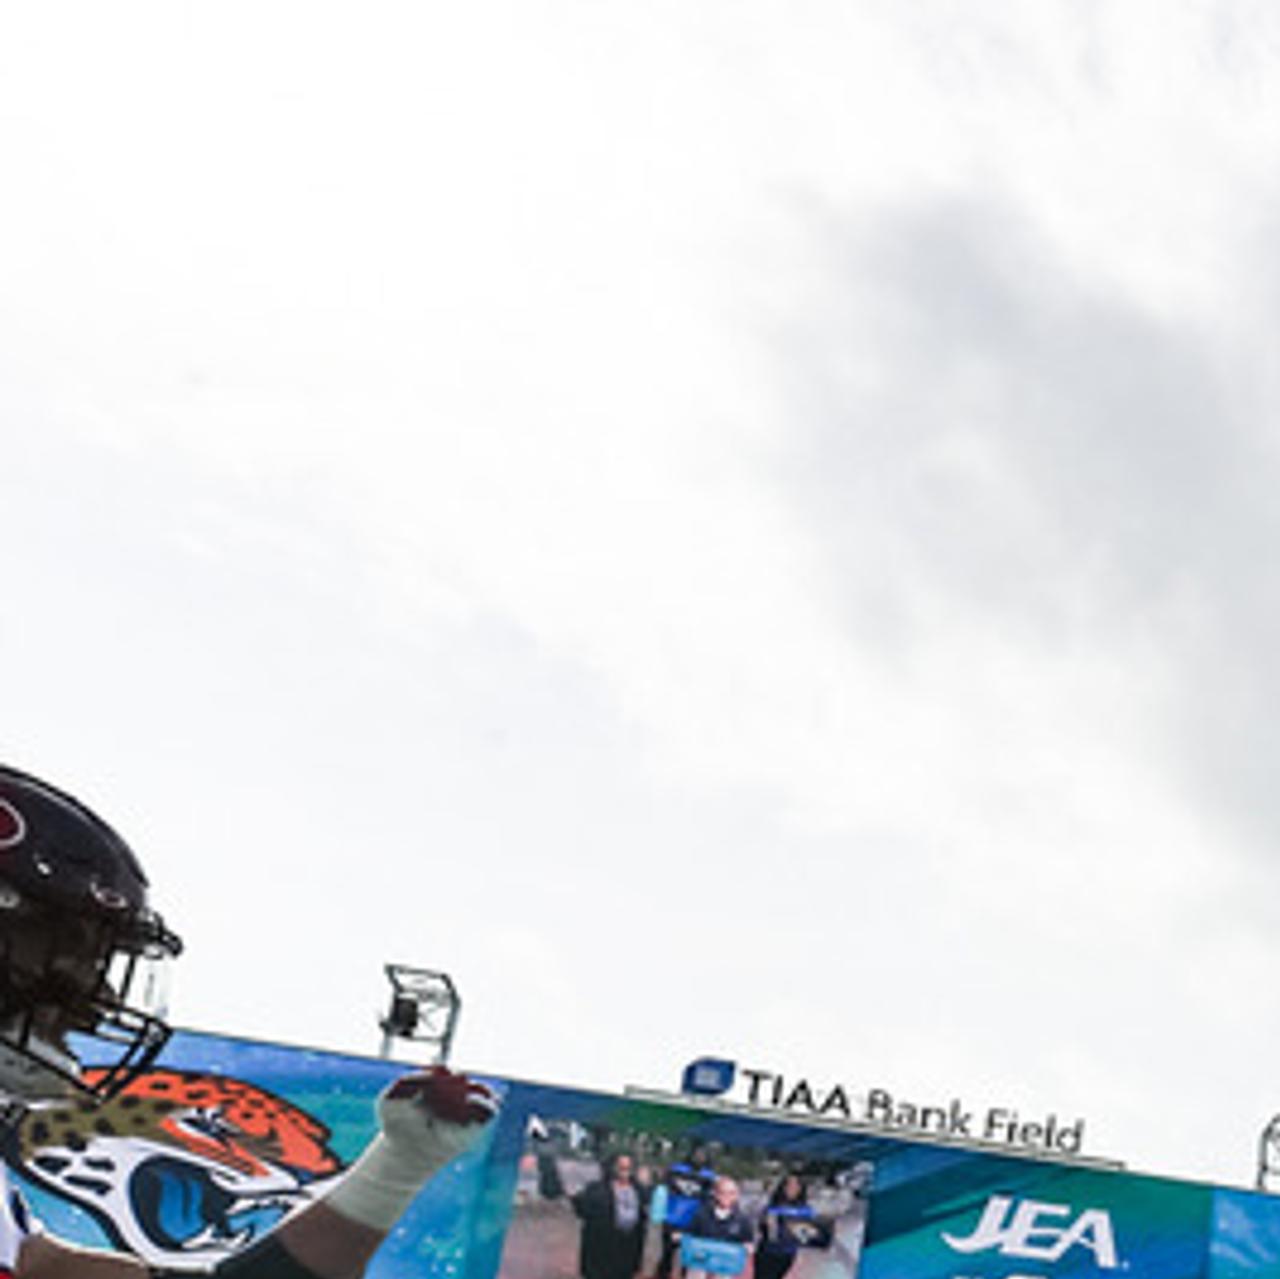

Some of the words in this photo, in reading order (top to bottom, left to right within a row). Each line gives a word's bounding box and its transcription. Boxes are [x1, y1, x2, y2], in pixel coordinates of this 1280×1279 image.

[742, 1068, 852, 1118] TIAA
[864, 1088, 972, 1136] Bank
[984, 1107, 1086, 1154] Field
[940, 1196, 1119, 1269] JEA
